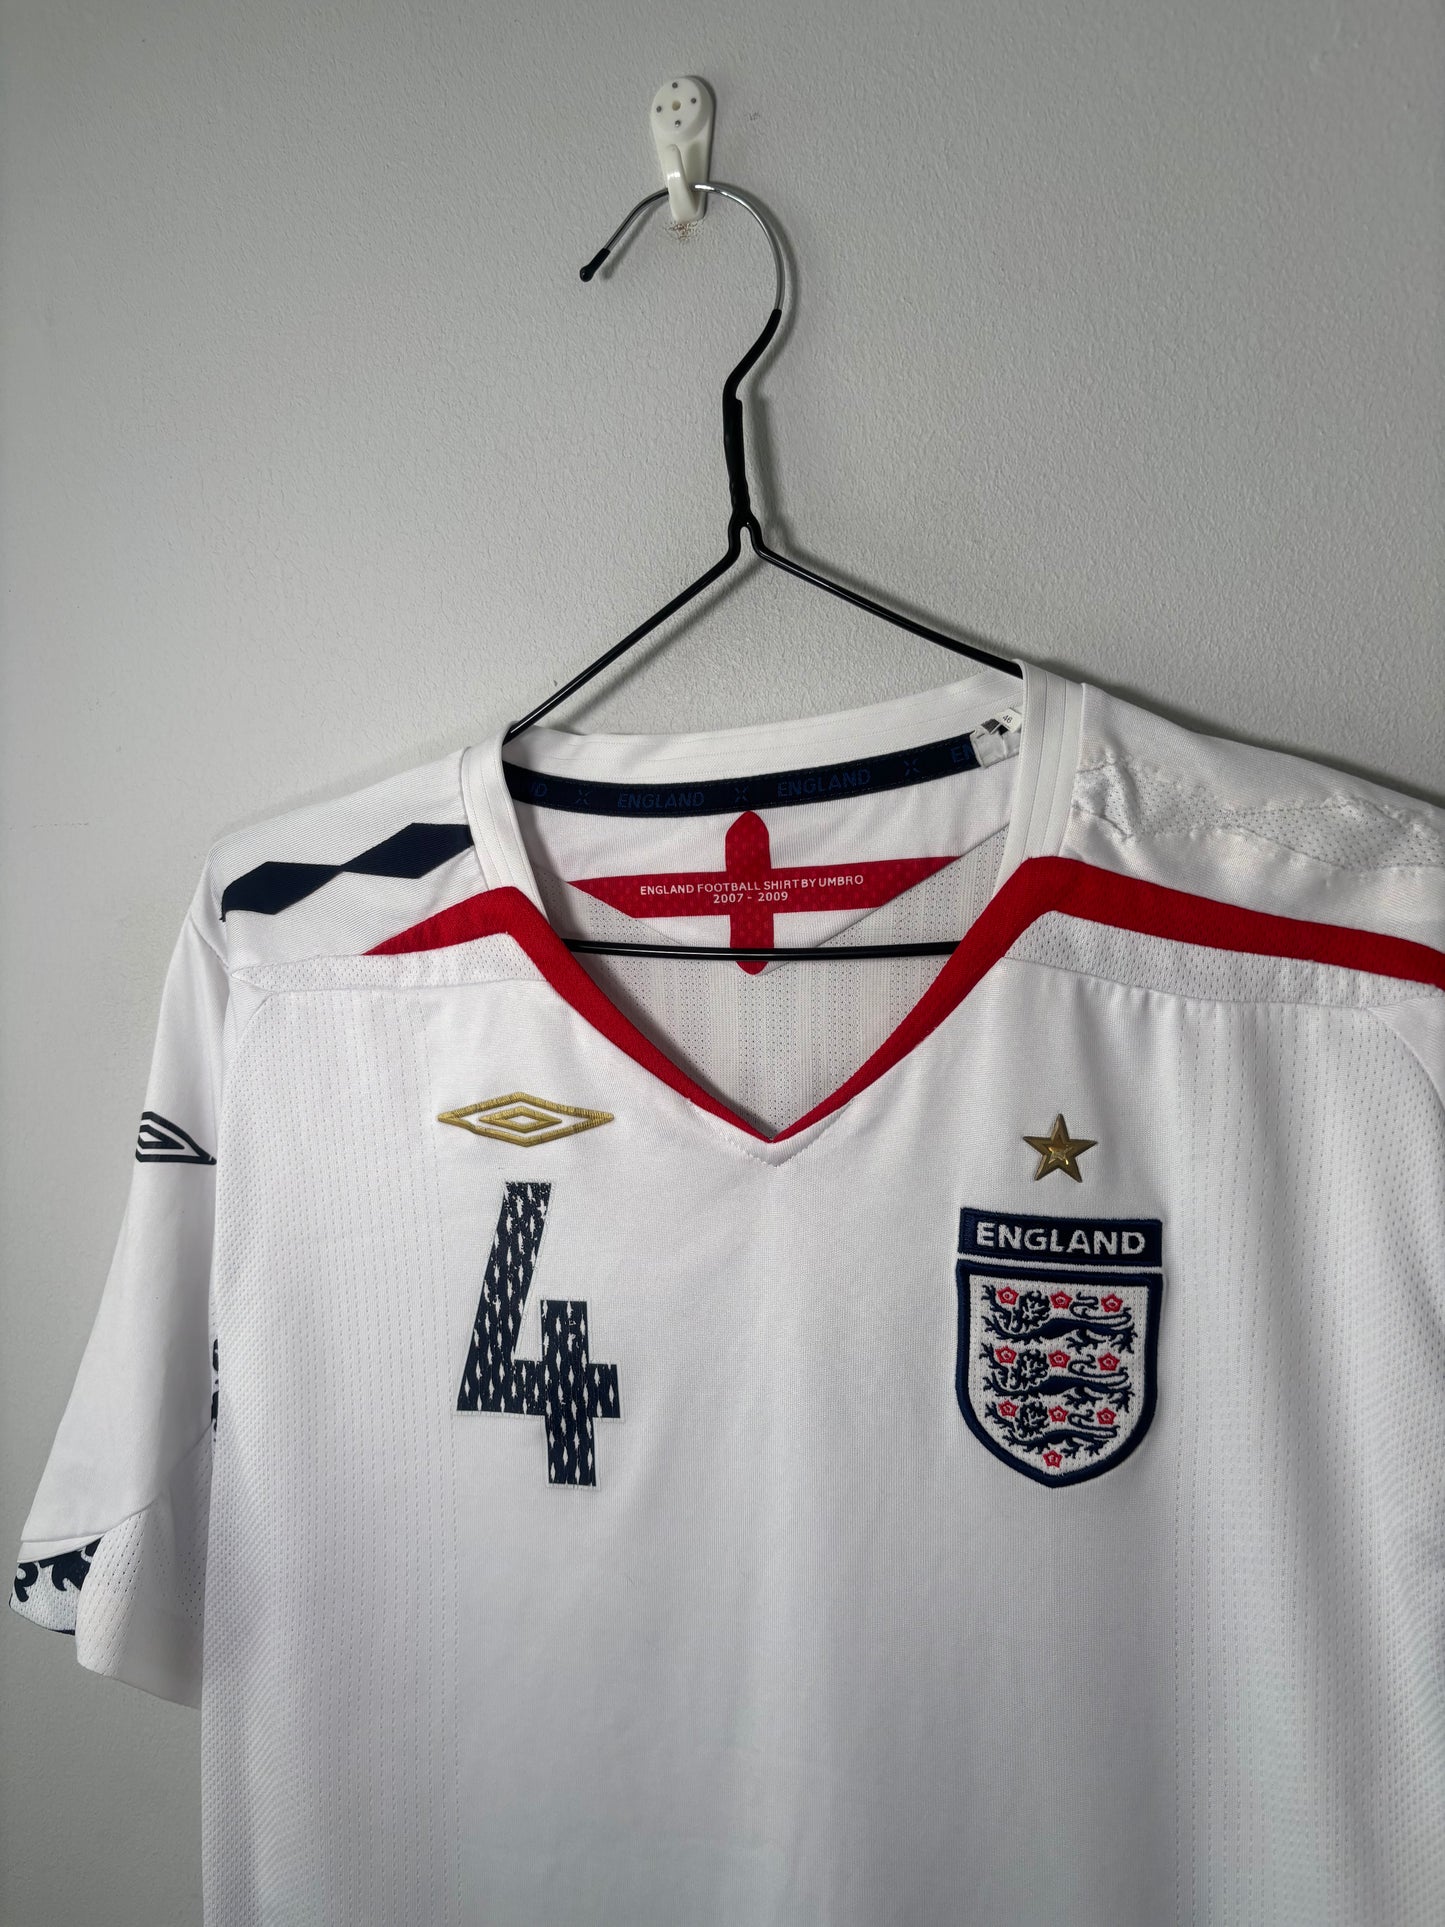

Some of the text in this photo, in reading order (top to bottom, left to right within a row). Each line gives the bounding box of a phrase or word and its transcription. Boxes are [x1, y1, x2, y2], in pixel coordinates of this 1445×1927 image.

[618, 768, 872, 809] ENGLAND ENGLAND
[640, 875, 864, 896] ENGLAND FOOTBALL SHIRT BY UMBRO
[713, 893, 744, 904] 2007
[758, 891, 788, 902] 2009
[976, 1220, 1146, 1256] ENGLAND
[456, 1181, 621, 1486] 4
